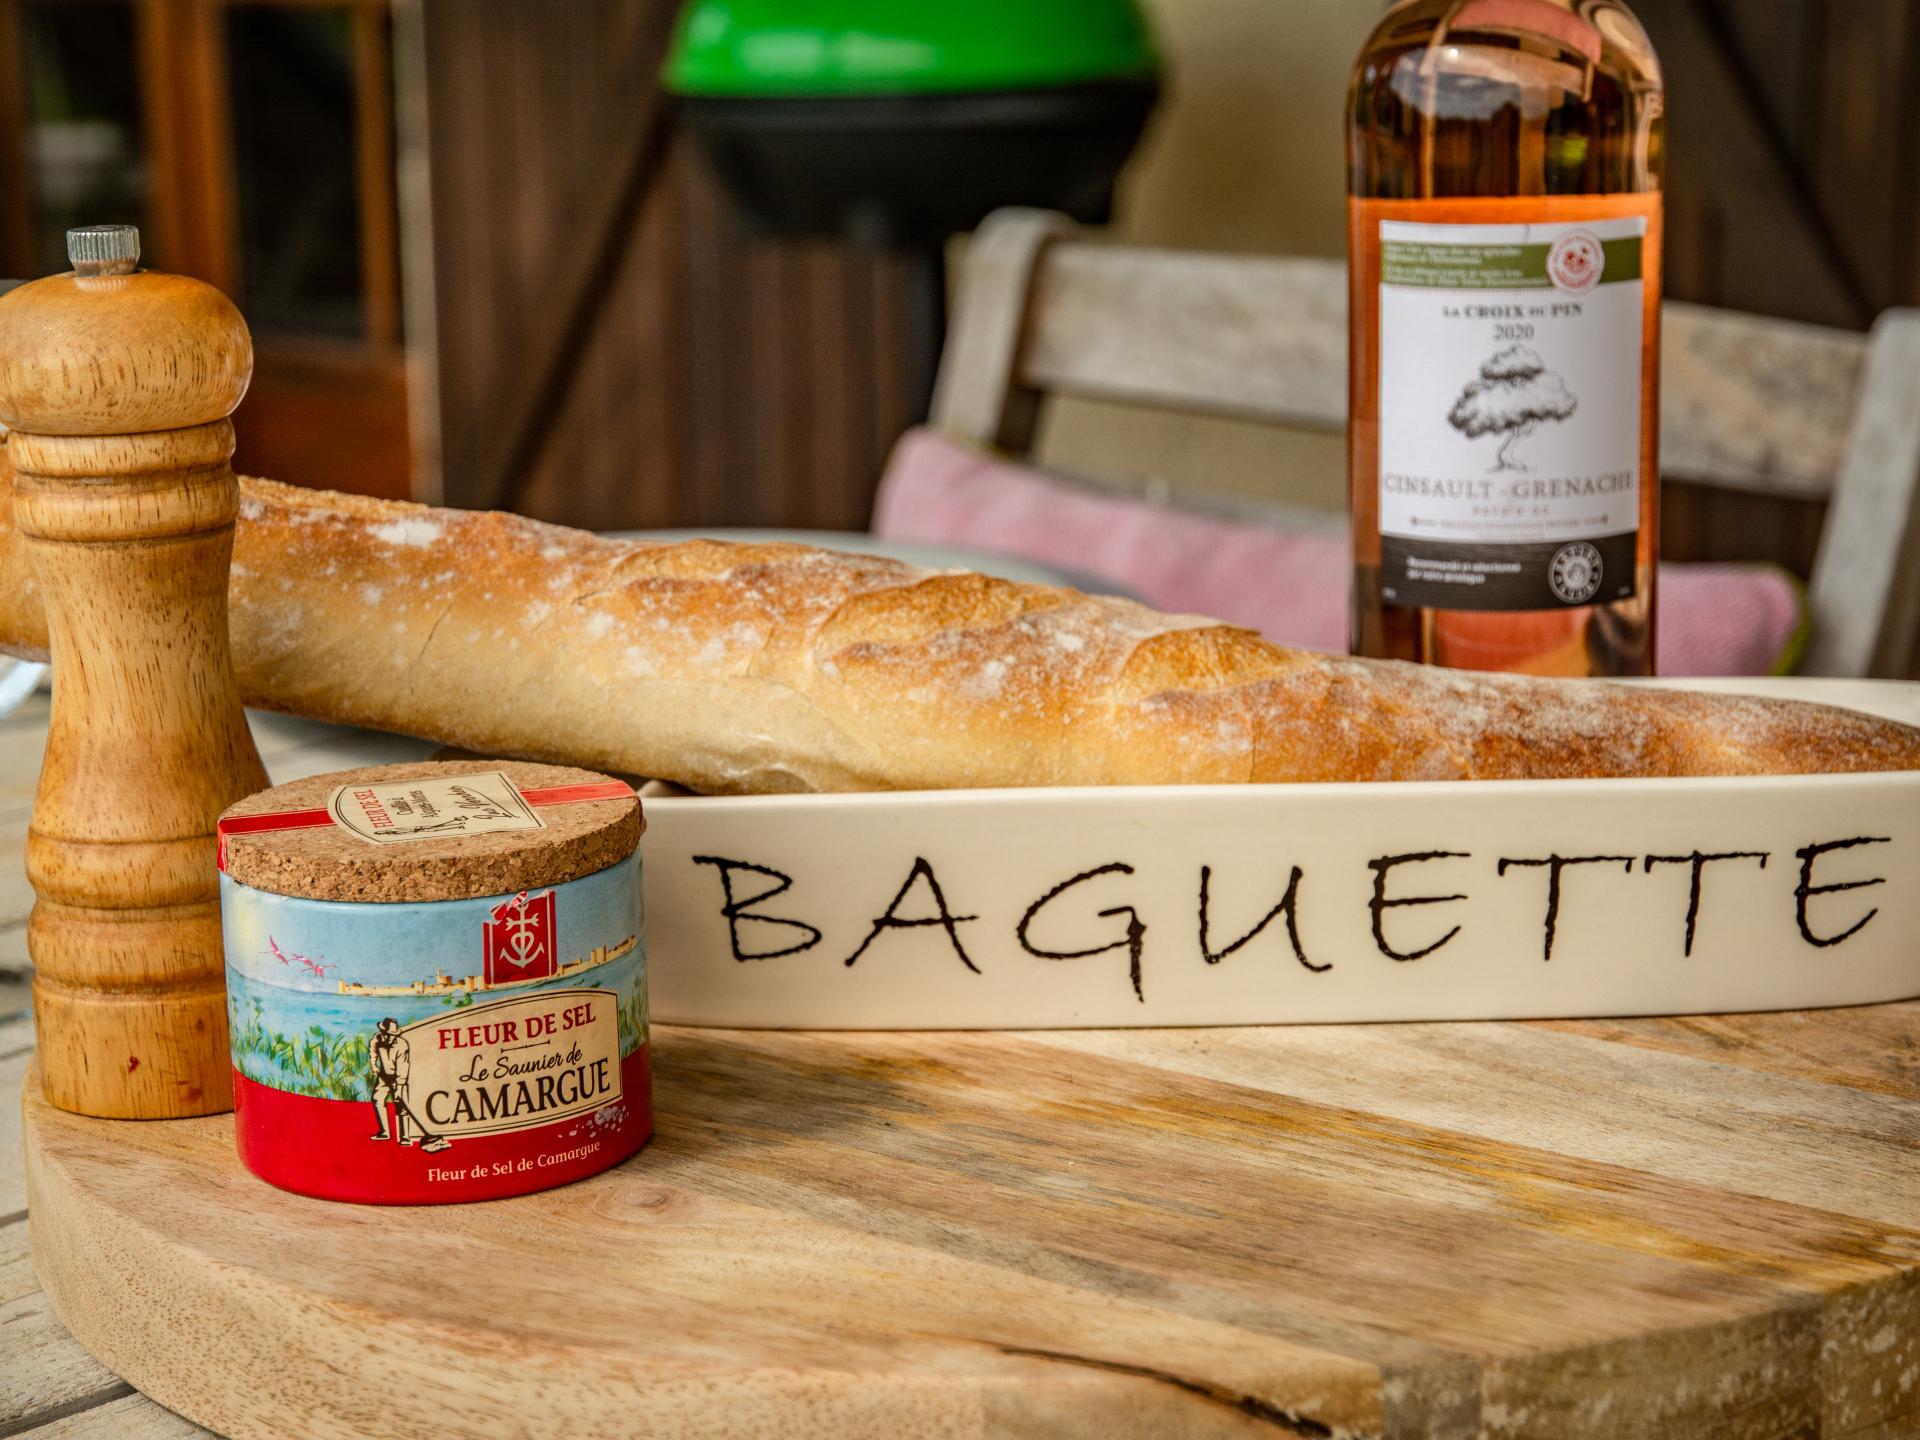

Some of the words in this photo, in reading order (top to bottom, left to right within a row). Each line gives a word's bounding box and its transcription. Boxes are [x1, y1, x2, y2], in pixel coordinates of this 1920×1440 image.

[1464, 304, 1524, 319] CROIX
[1550, 302, 1583, 317] PIN
[1492, 323, 1535, 341] 2020
[1382, 472, 1495, 499] CINSAULT
[1510, 469, 1635, 499] GRENACHE
[364, 808, 395, 828] FLEUR
[692, 837, 1892, 1003] BAGUETTE
[437, 1021, 520, 1050] FLEUR
[524, 1012, 557, 1038] DE
[561, 1002, 596, 1031] SEL
[458, 1054, 490, 1082] Le
[493, 1053, 564, 1079] Saunier
[565, 1041, 582, 1066] de
[425, 1057, 611, 1126] CAMARGUE
[427, 1168, 466, 1182] Fleur
[470, 1165, 488, 1178] de
[493, 1161, 514, 1176] Sel
[517, 1158, 534, 1173] de
[537, 1140, 600, 1168] Camargue
